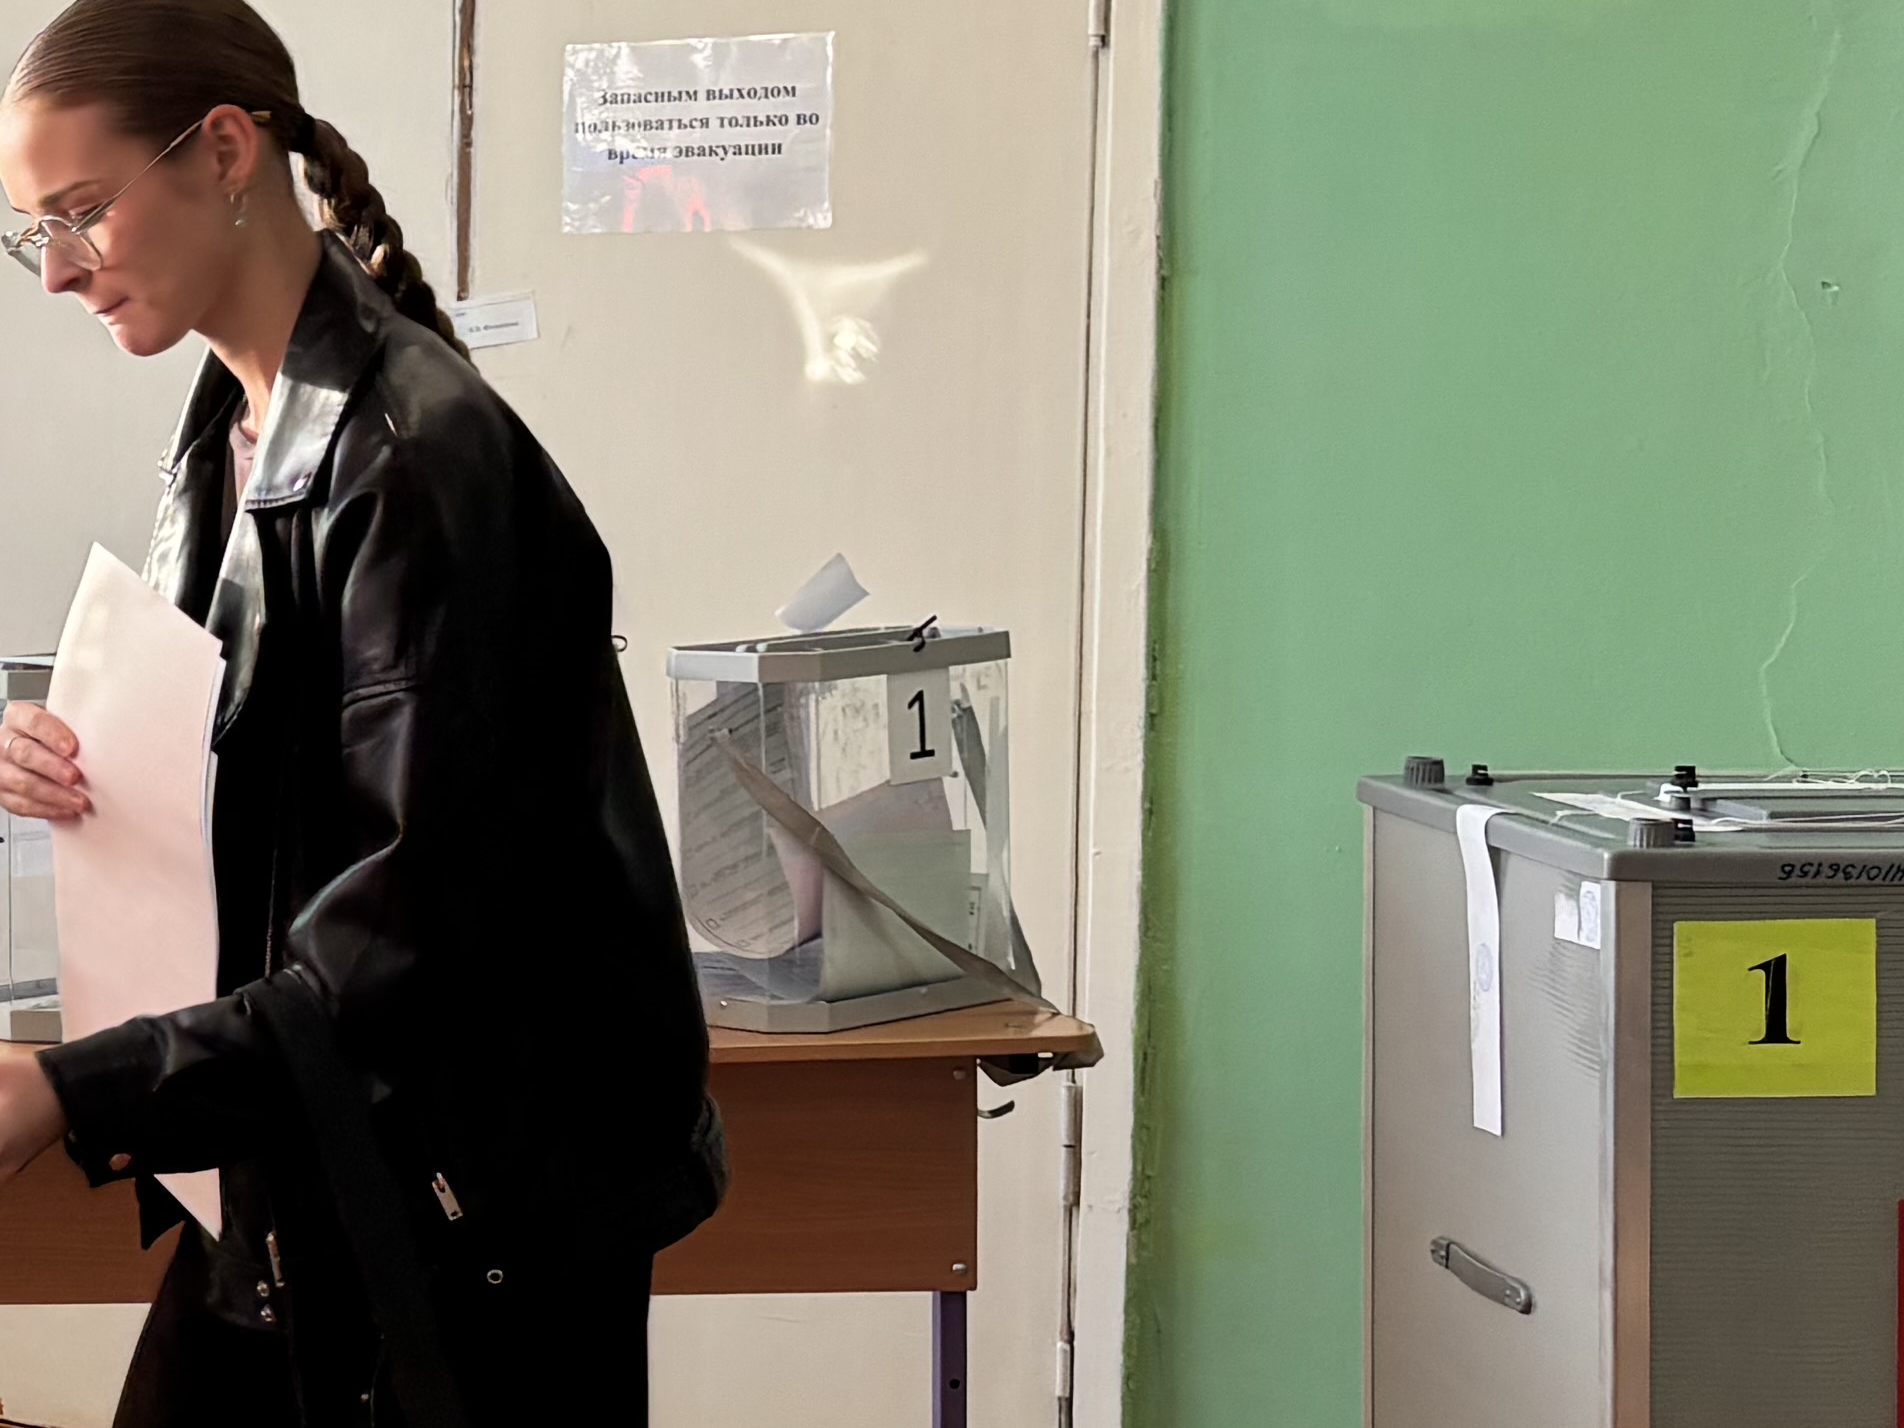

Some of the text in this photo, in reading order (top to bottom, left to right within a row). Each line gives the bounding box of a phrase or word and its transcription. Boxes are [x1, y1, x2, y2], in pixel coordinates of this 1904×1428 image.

[597, 85, 798, 106] Запасным выходом
[574, 112, 820, 134] пользоваться только во
[672, 141, 783, 161] эвакуации
[907, 689, 935, 760] 1
[1747, 953, 1802, 1045] 1
